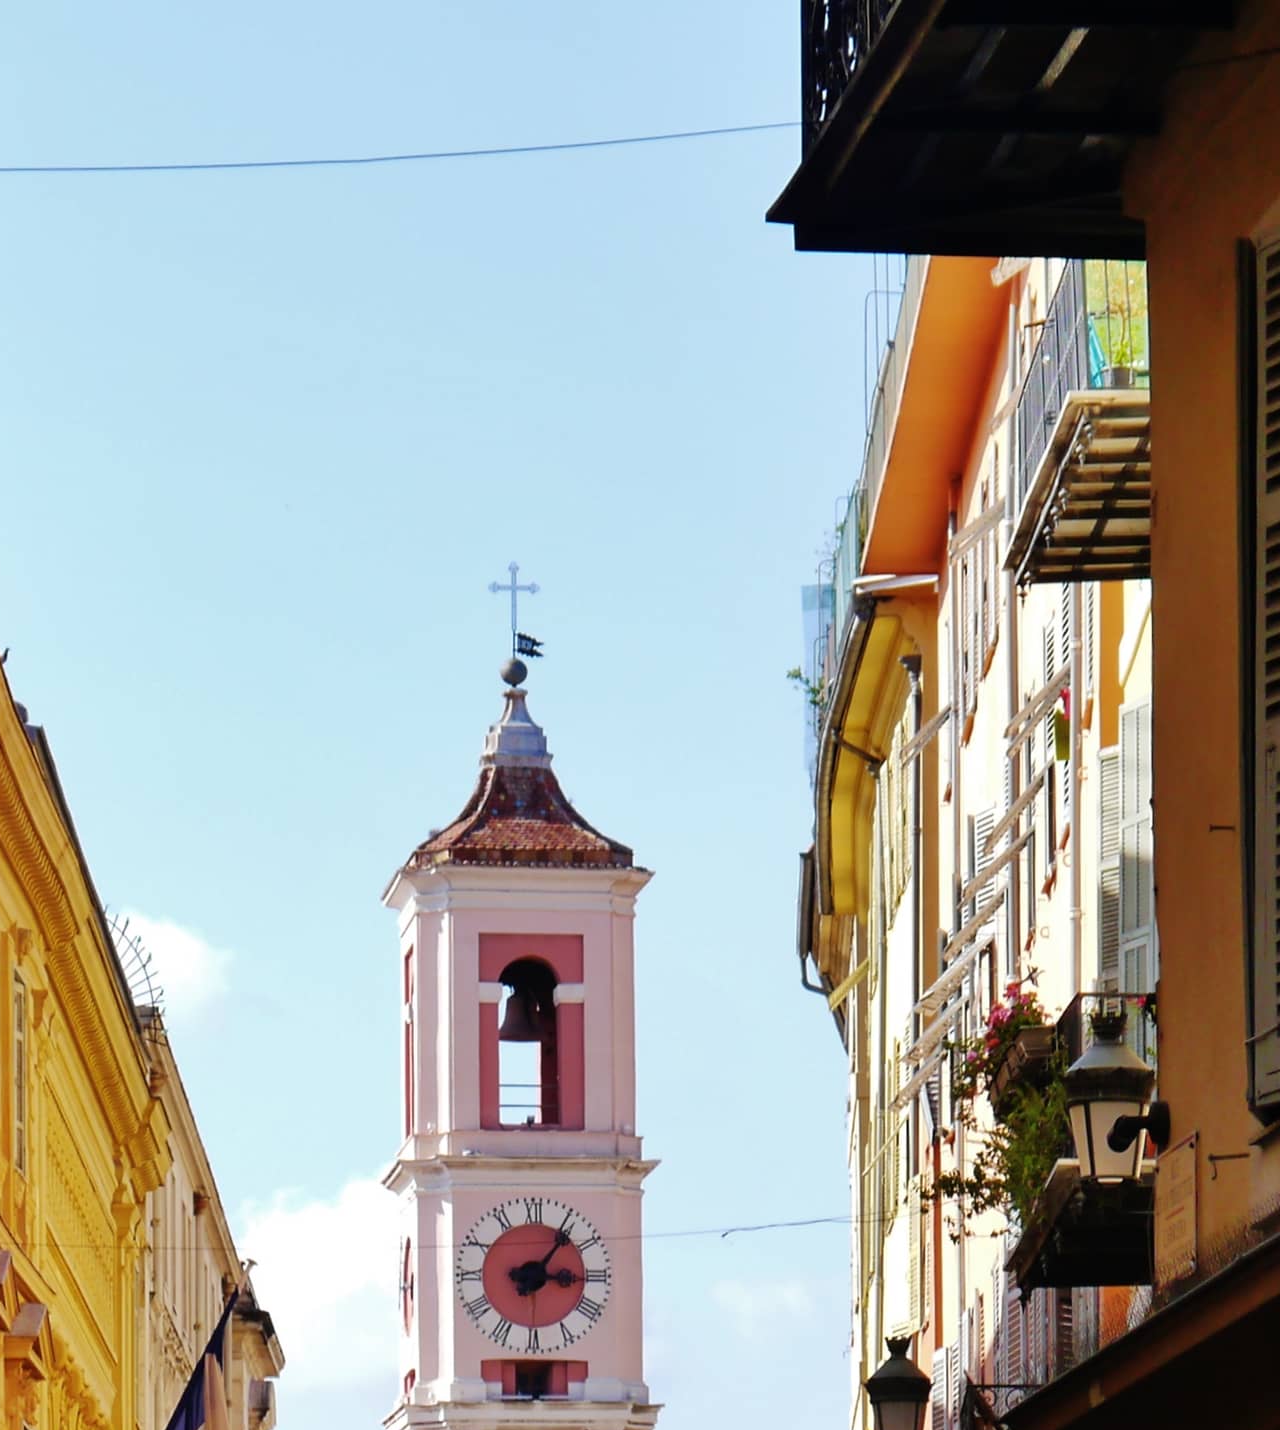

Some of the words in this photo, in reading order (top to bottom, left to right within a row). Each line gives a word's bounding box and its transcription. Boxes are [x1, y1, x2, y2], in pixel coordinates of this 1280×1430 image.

[493, 1208, 513, 1231] XI
[525, 1203, 542, 1224] XII
[586, 1269, 607, 1282] III
